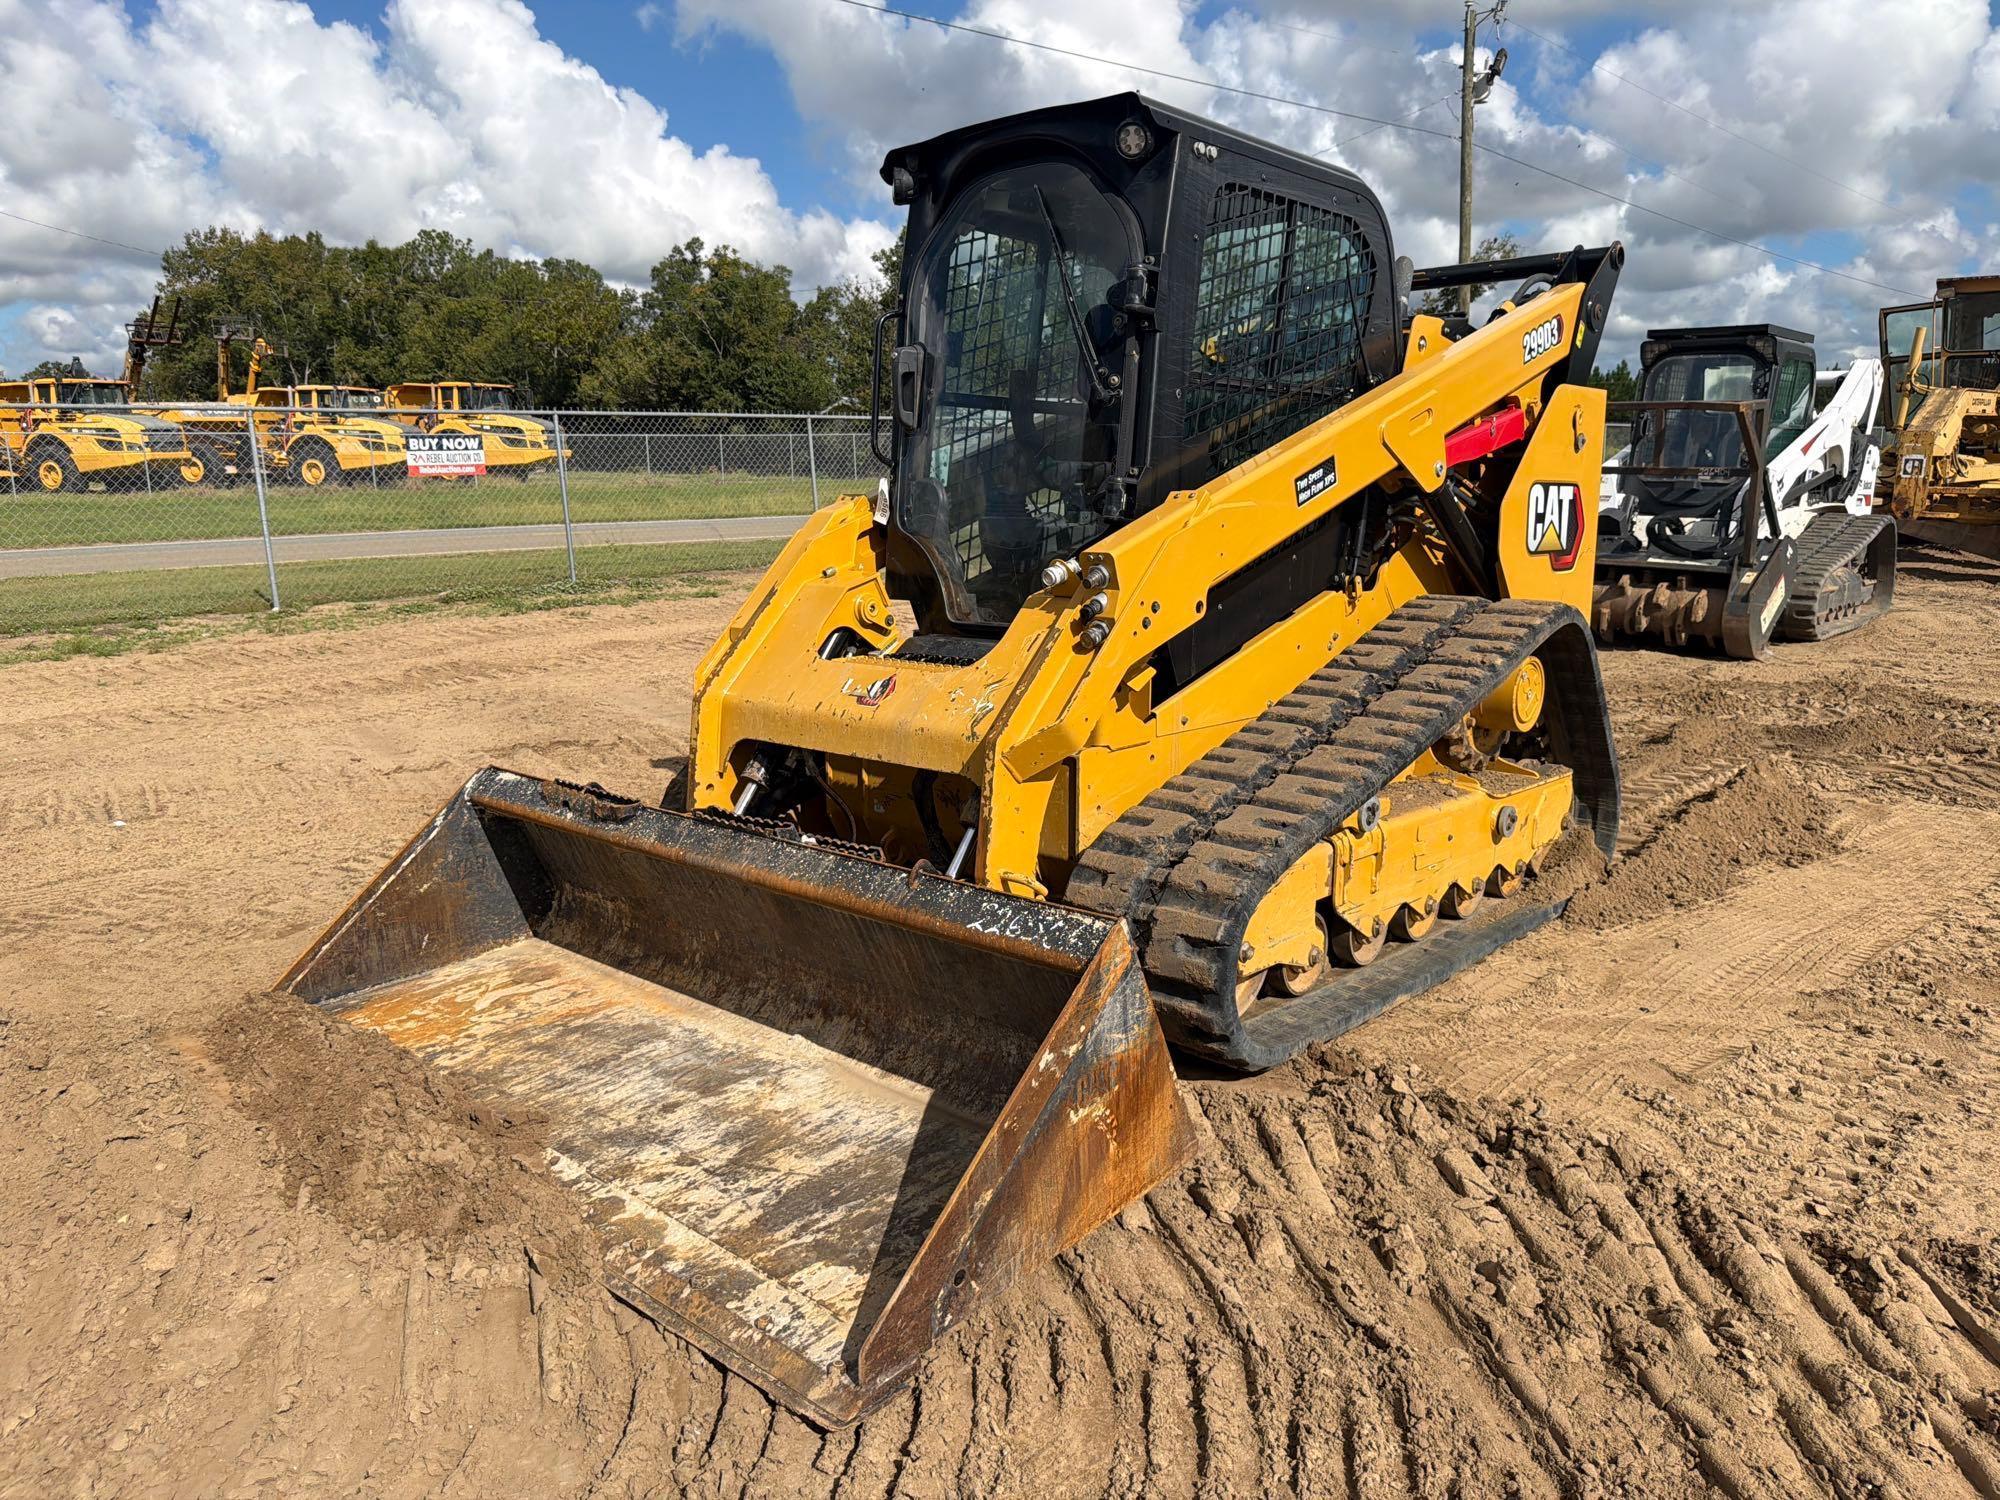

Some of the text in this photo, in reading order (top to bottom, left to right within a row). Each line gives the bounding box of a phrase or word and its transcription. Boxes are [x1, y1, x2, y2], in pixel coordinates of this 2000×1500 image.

[1523, 318, 1559, 363] 299D3
[409, 437, 480, 450] BUY NOW
[426, 453, 445, 464] REBEL
[446, 452, 472, 464] AUCTION
[1527, 483, 1574, 552] CAT
